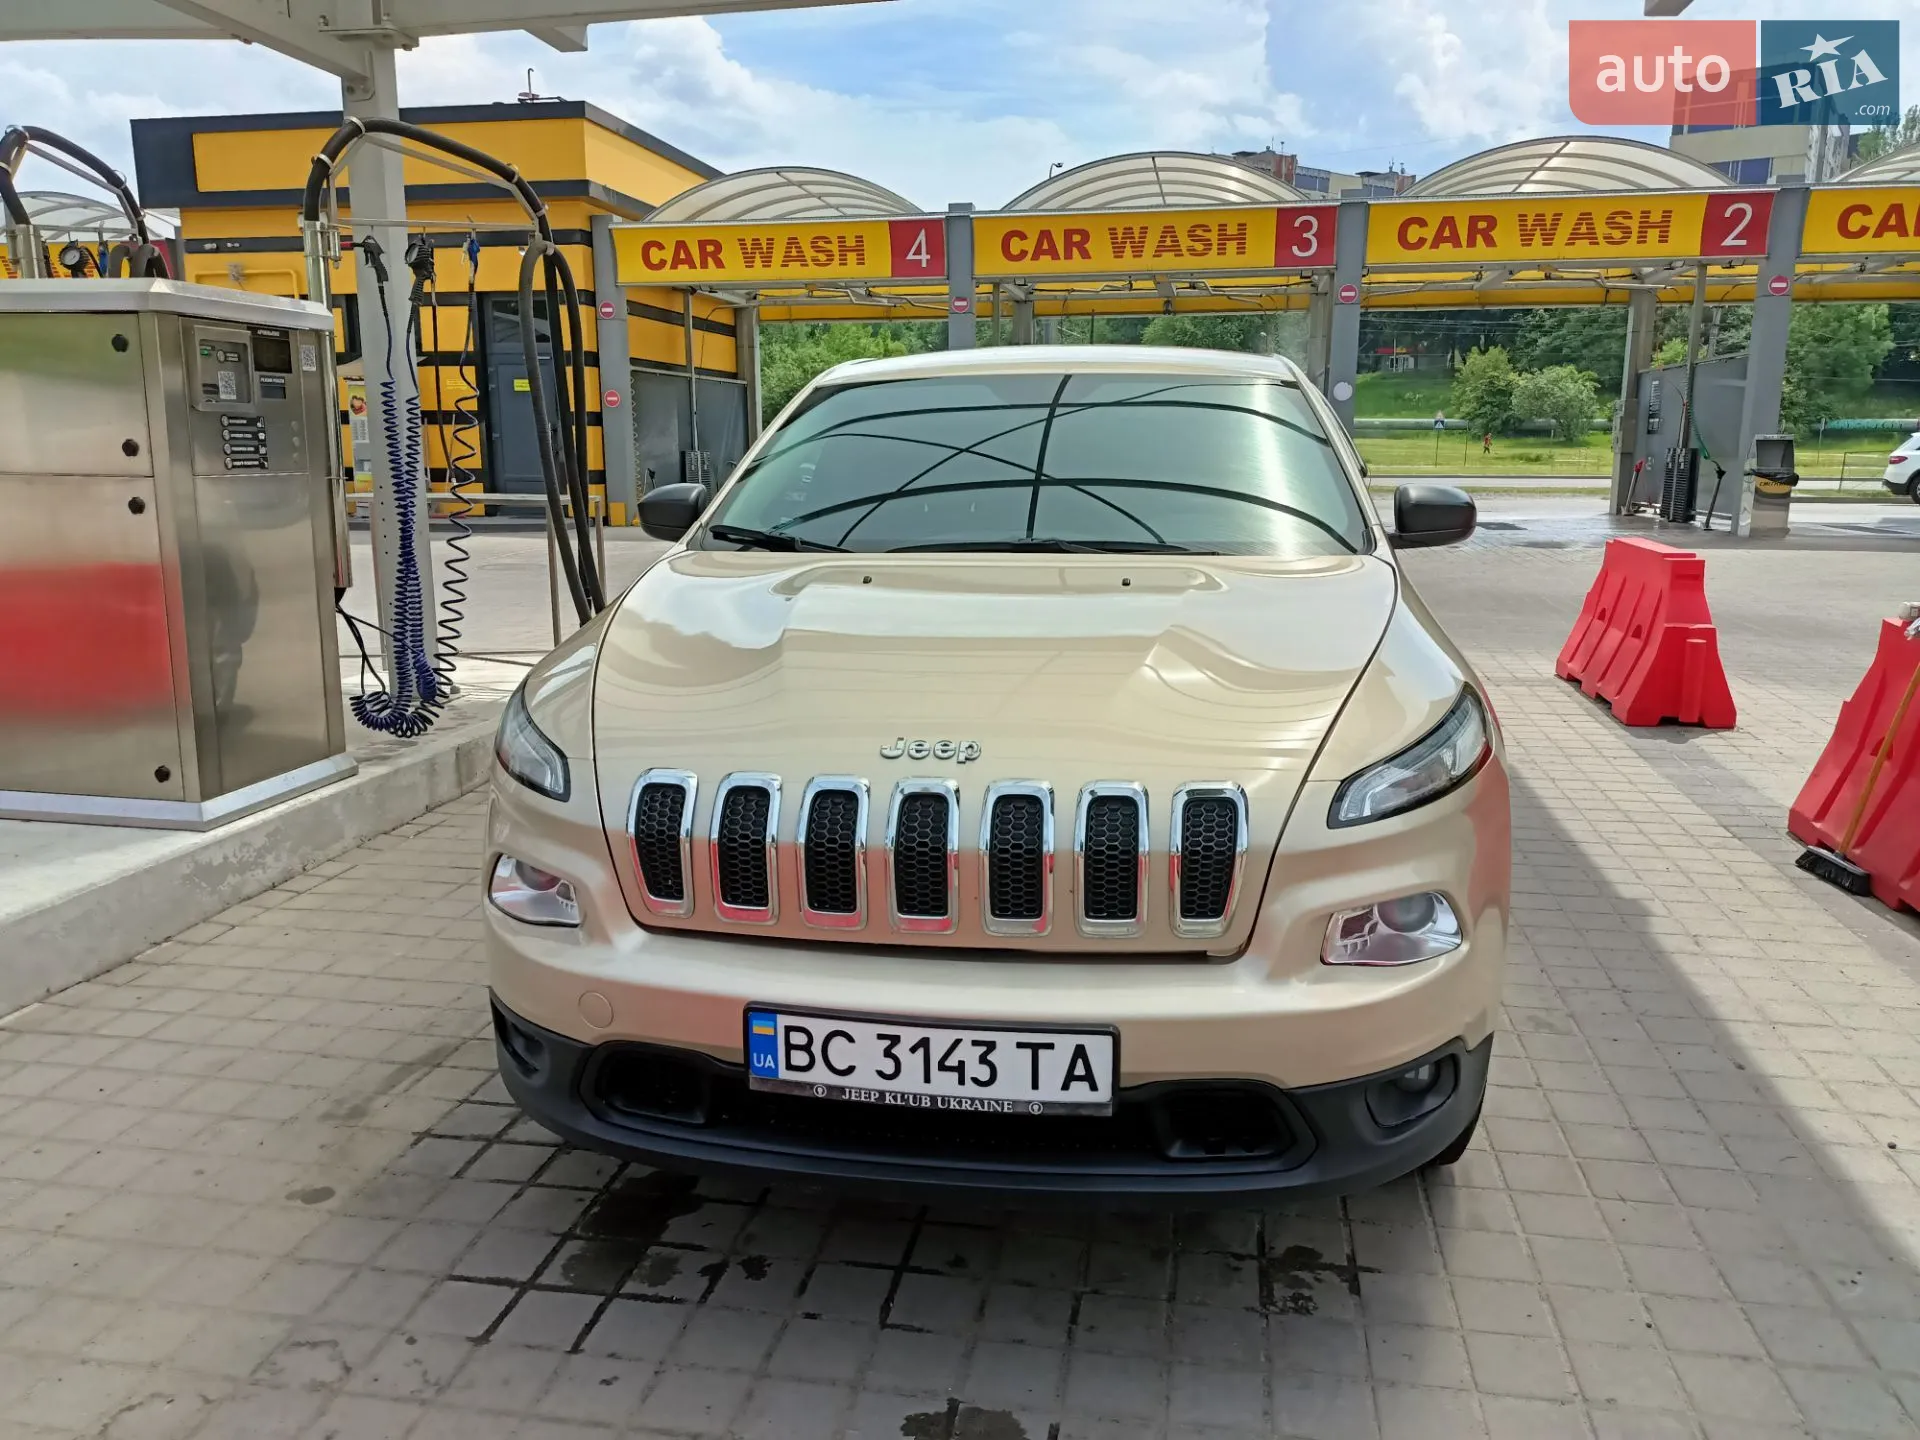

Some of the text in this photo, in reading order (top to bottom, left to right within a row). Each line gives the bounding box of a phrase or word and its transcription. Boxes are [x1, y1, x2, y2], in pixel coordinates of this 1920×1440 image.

[1001, 215, 1319, 262] CAR WASH 3
[1397, 202, 1753, 250] CAR WASH 2
[1837, 203, 1920, 240] CA
[641, 228, 931, 272] CAR WASH 4
[880, 737, 982, 764] Jeep
[753, 1053, 776, 1070] UA
[783, 1024, 1100, 1092] BC 3143 TA
[842, 1088, 879, 1103] JEEP
[937, 1096, 1014, 1114] UKRAINE
